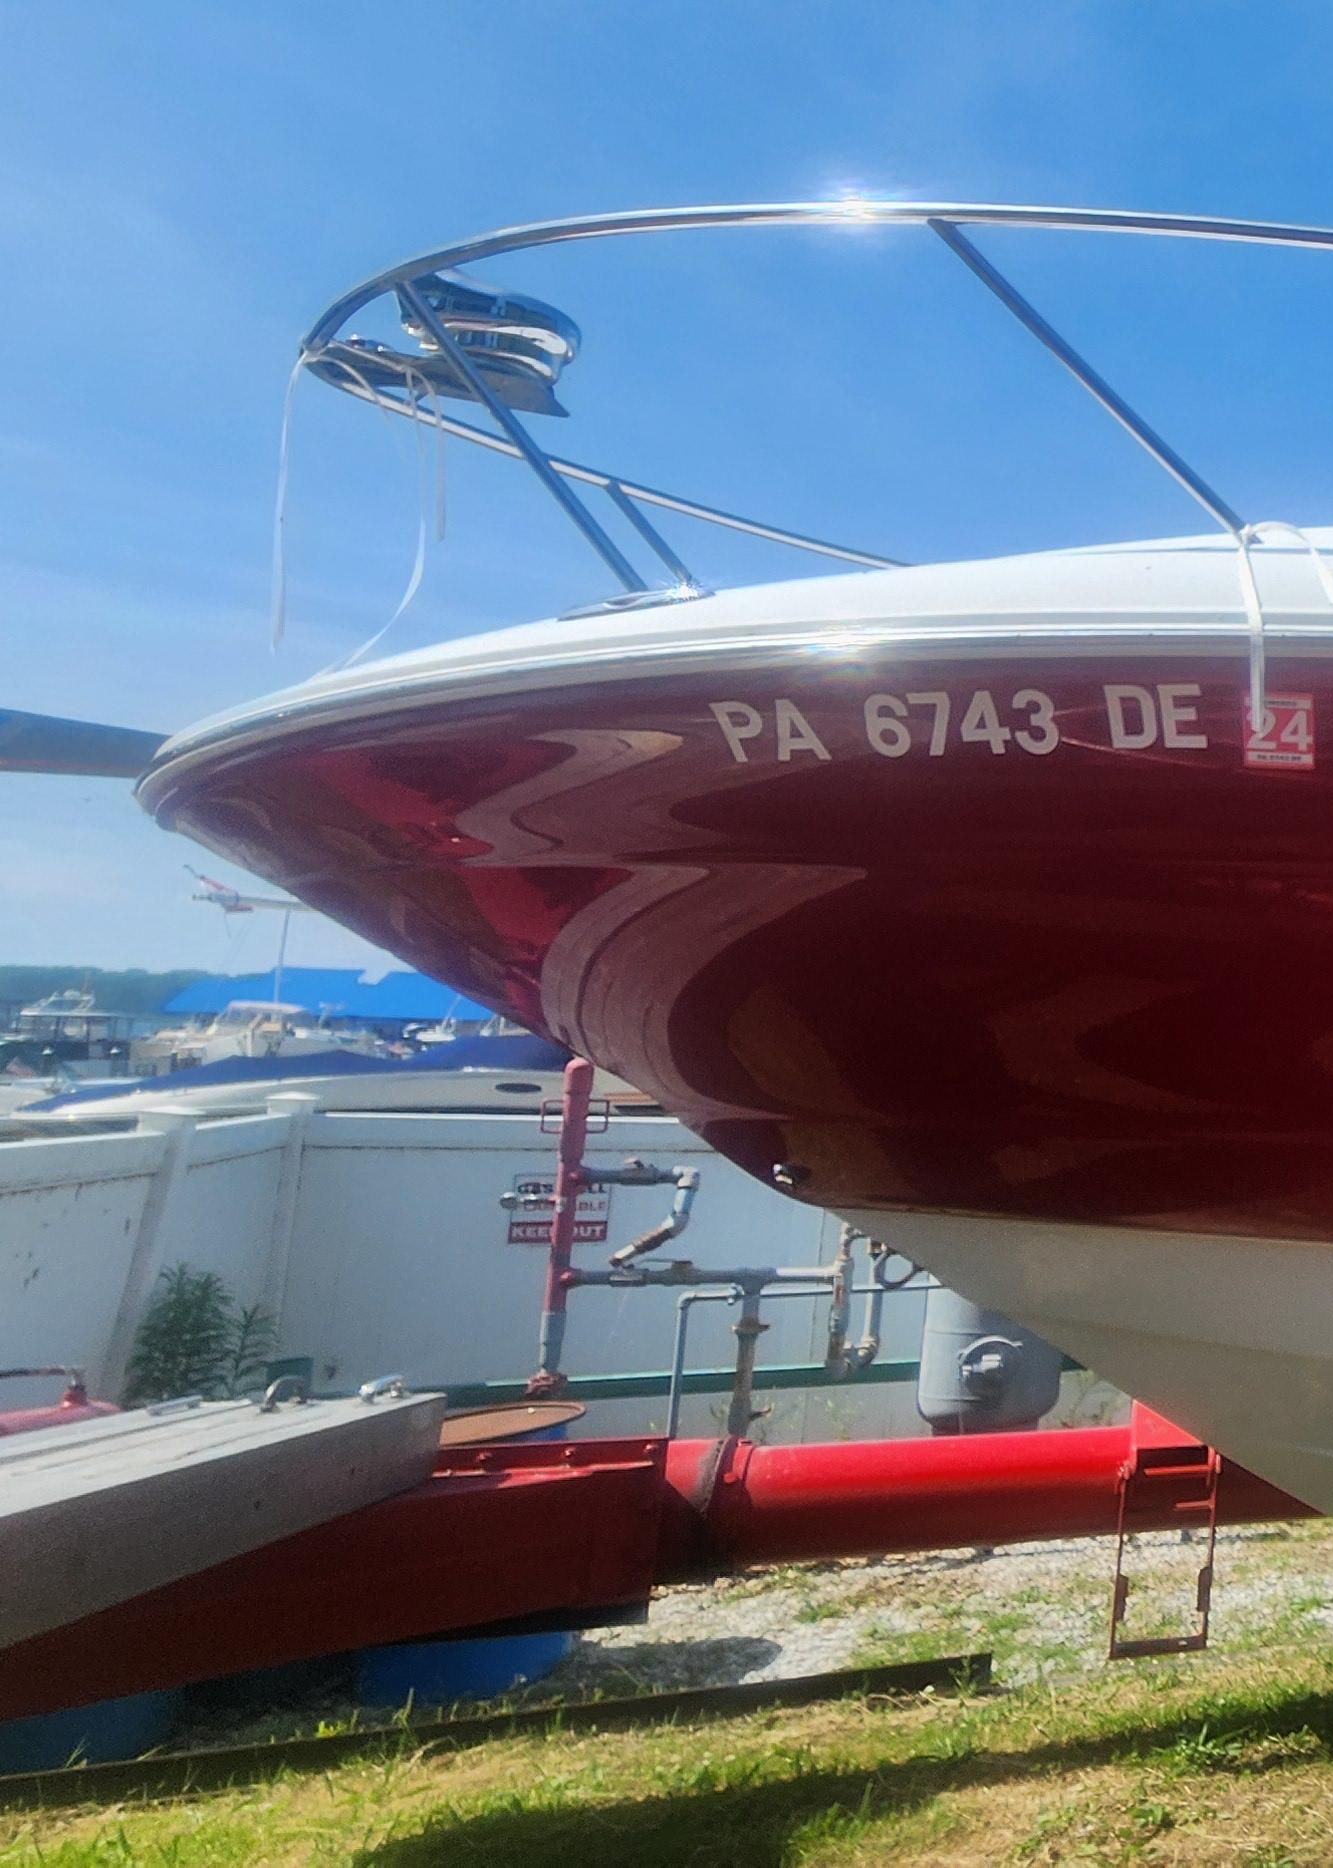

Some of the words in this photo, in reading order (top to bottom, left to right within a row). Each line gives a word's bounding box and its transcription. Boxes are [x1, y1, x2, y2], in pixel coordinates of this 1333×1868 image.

[708, 699, 832, 762] PA
[864, 689, 1060, 758] 6743
[1103, 684, 1208, 749] DE
[1246, 709, 1313, 752] 24
[511, 1226, 553, 1239] KEE
